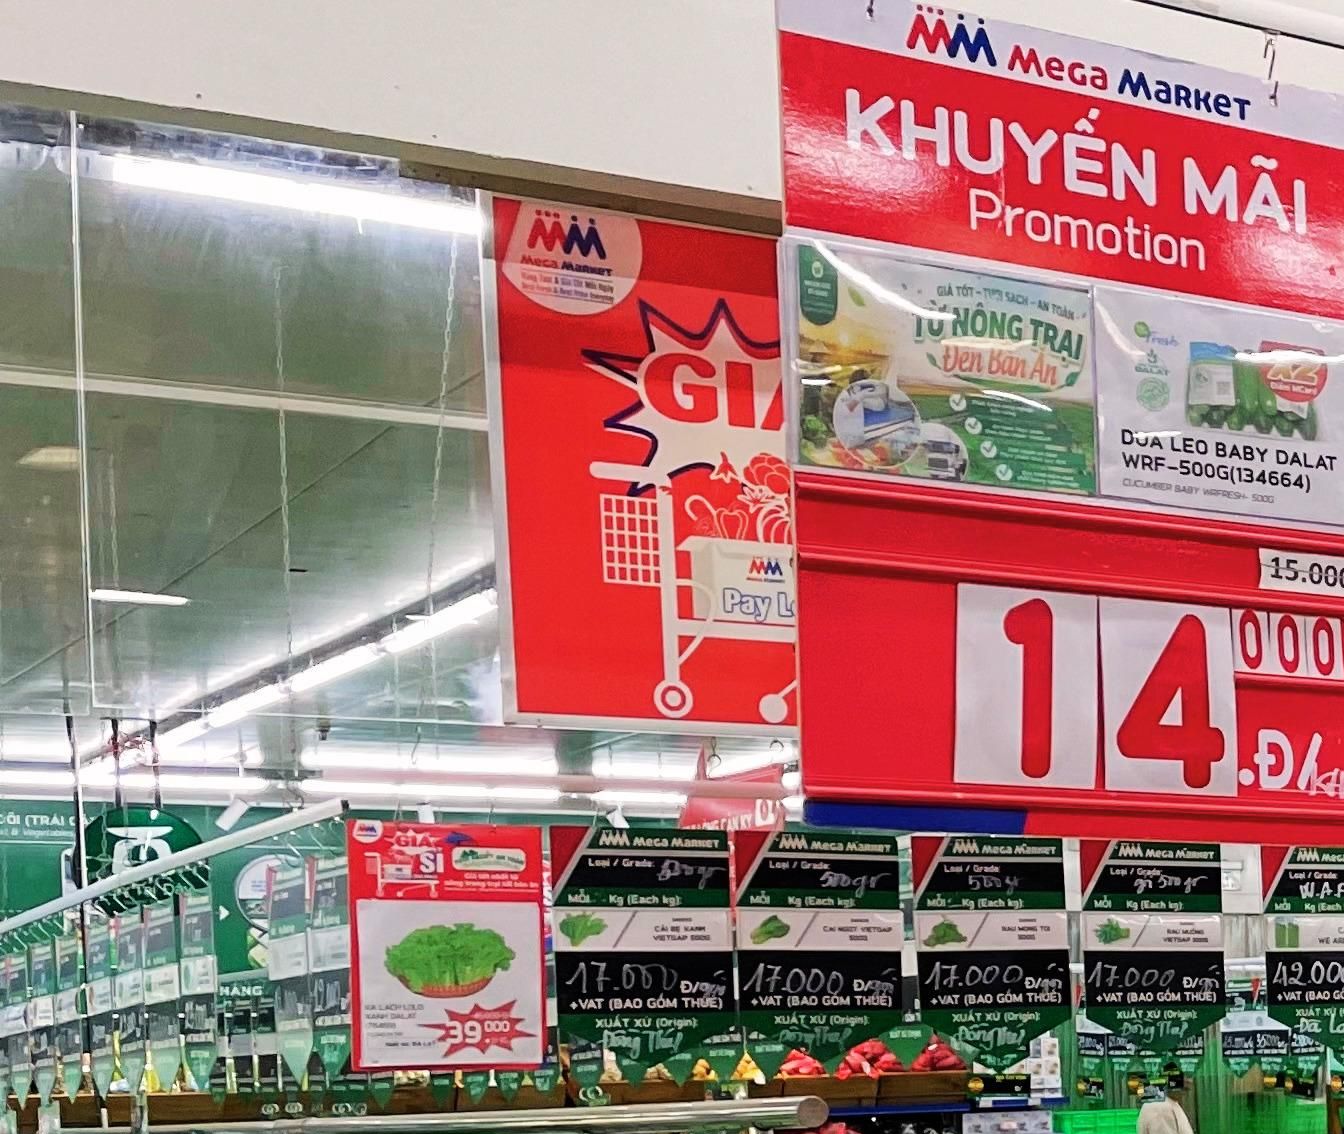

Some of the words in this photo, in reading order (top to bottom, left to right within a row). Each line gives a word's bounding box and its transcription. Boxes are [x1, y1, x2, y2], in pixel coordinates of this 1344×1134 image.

[845, 89, 1155, 208] KHUYẾN
[1184, 155, 1307, 234] MÃI
[970, 189, 1206, 270] Promotion
[952, 302, 1023, 341] NÔNG
[1029, 319, 1083, 362] TRẠI
[1170, 437, 1209, 455] LEO
[1215, 442, 1268, 462] BABY
[1276, 450, 1338, 471] DALAT
[1175, 483, 1200, 495] BABY
[722, 588, 772, 624] Pay
[1004, 598, 1226, 790] 14
[628, 894, 660, 906] (Each
[609, 998, 643, 1011] (BAO
[1126, 991, 1154, 1003] (BAO
[1305, 990, 1331, 1002] (BAO
[446, 1020, 482, 1045] 39
